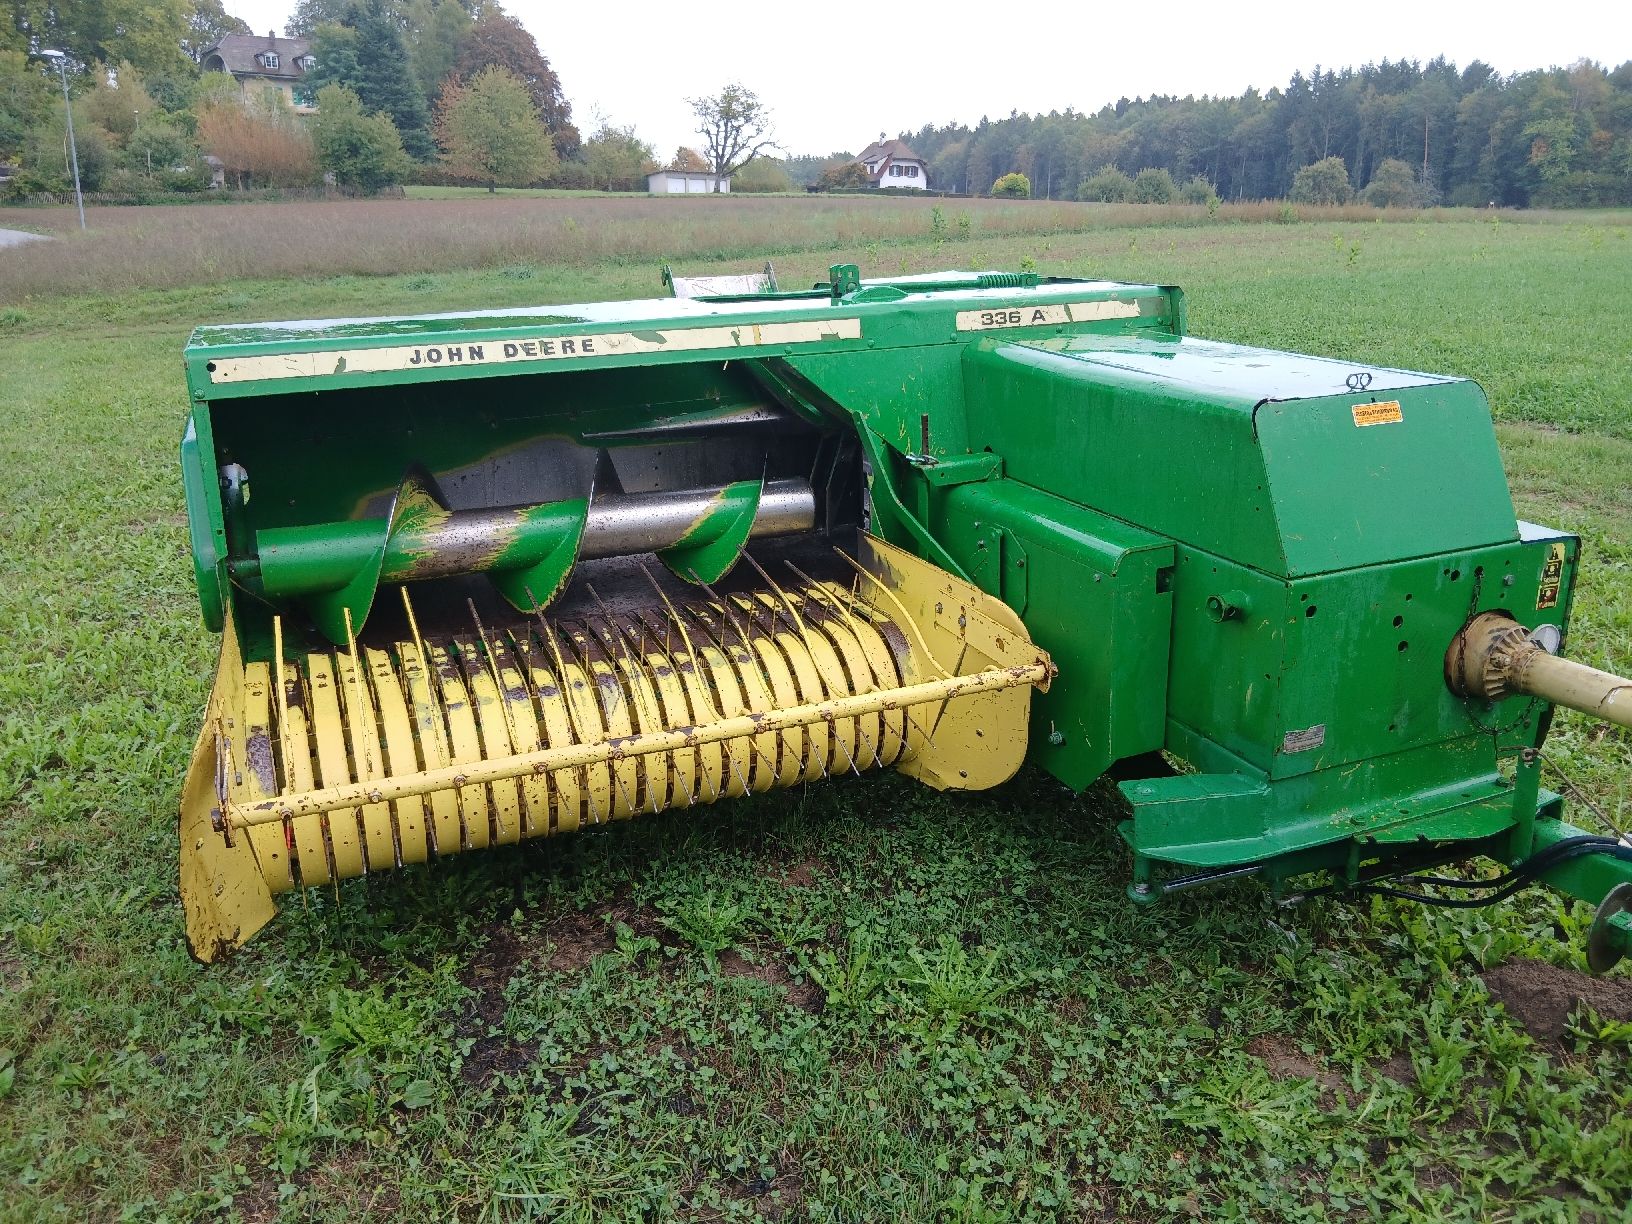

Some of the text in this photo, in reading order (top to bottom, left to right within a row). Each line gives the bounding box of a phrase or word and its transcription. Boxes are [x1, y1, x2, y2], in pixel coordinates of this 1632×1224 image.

[981, 310, 1046, 326] 336 A
[409, 338, 595, 365] JOHN DEERE
